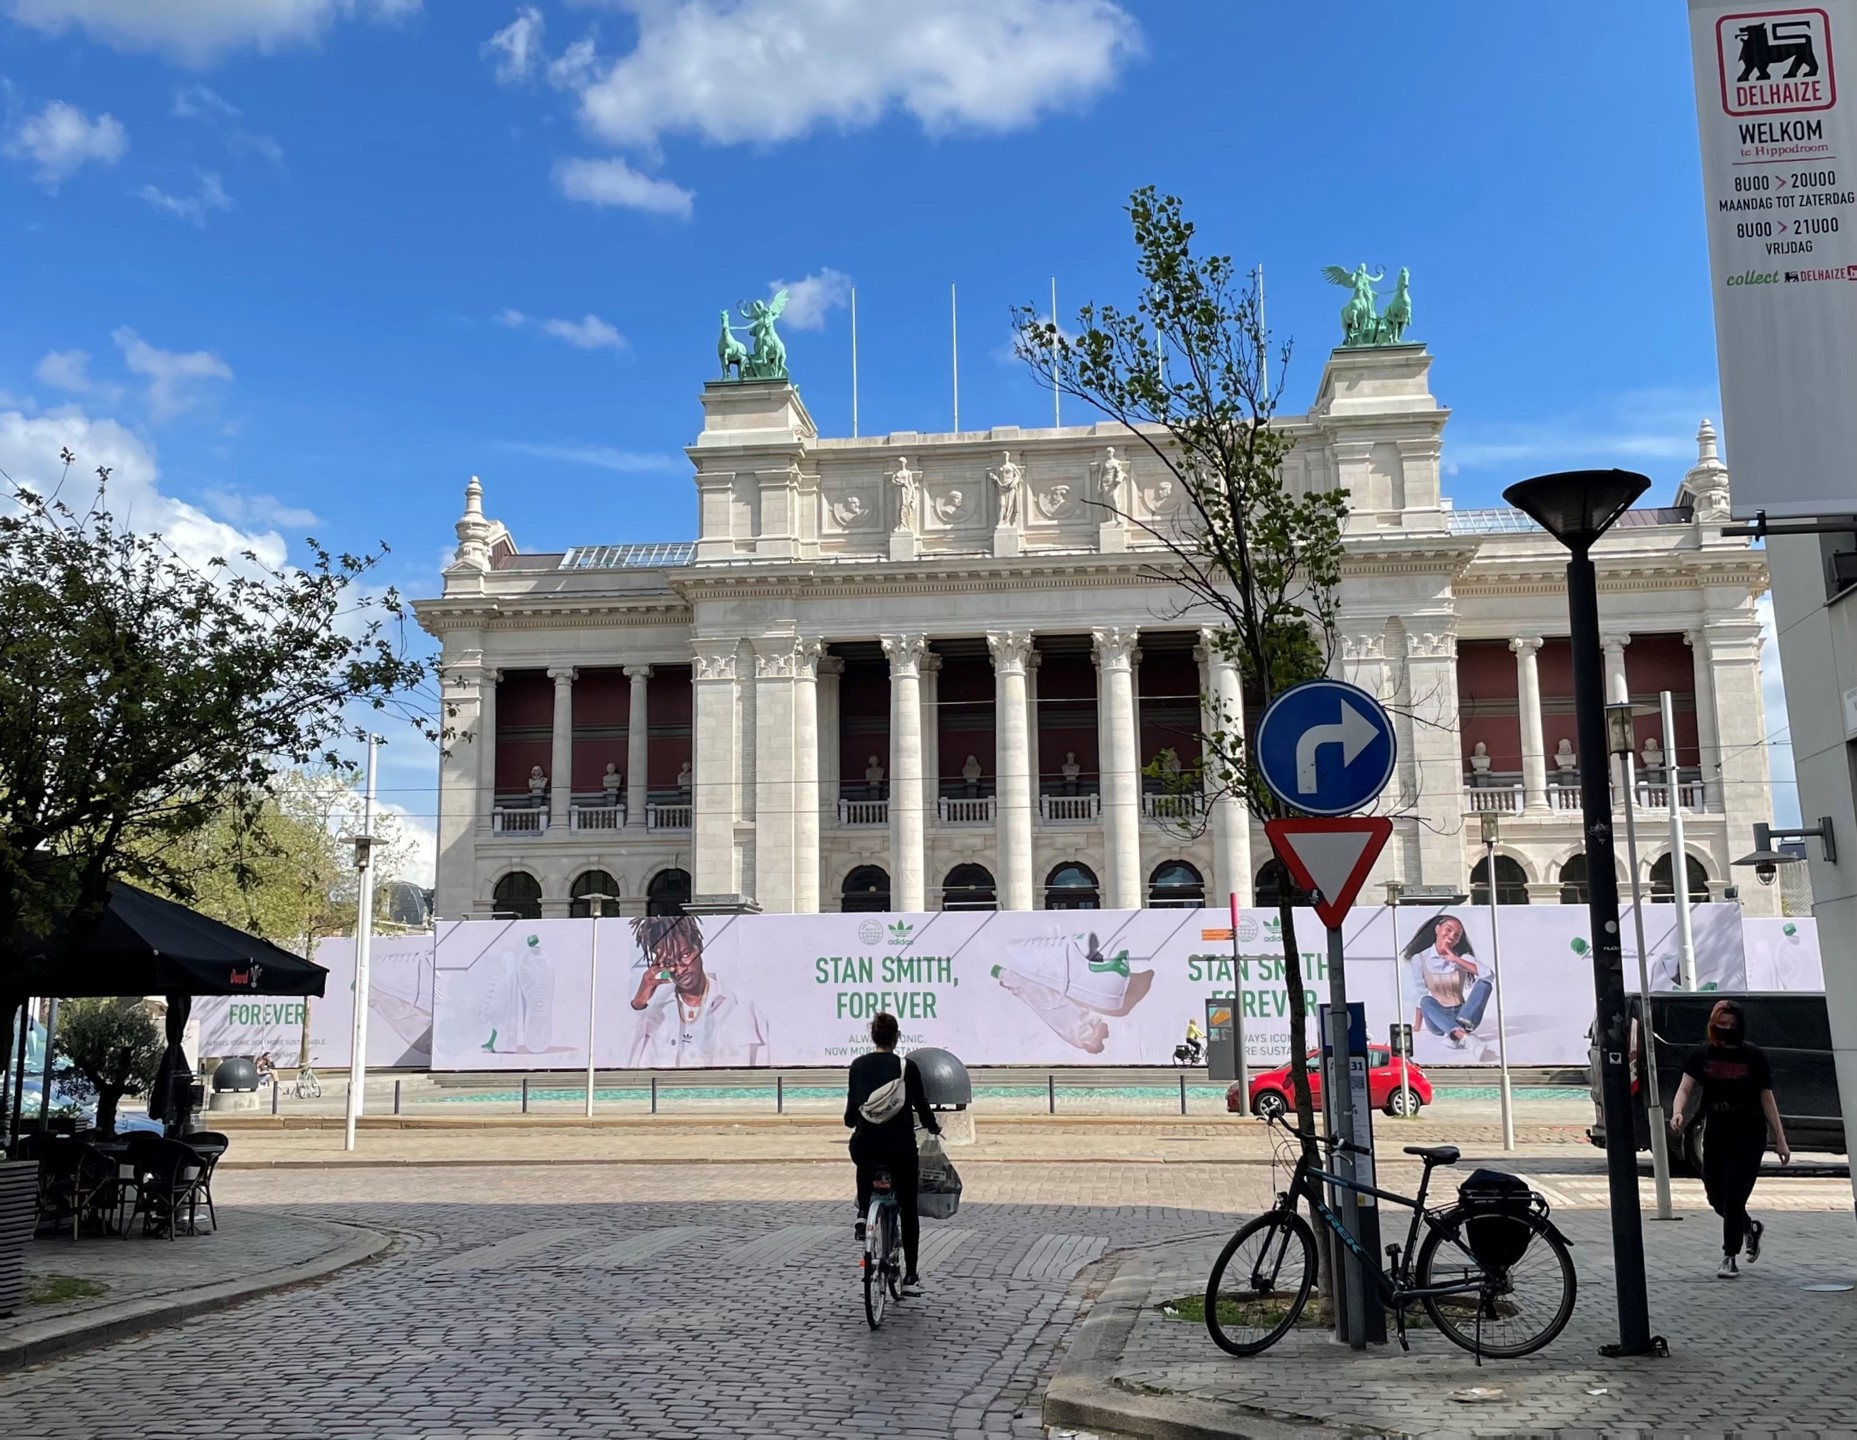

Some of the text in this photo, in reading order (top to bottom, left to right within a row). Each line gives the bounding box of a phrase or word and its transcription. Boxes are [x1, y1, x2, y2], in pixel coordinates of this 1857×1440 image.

[1736, 80, 1822, 107] DELHAIZE
[1739, 119, 1823, 144] WELKOM
[1741, 144, 1829, 157] te Hippodroom
[1734, 175, 1770, 192] 8U00
[1791, 170, 1836, 188] 20U00
[1719, 191, 1855, 212] MAANDAG TOT ZATERDAG
[1737, 222, 1772, 238] 8U00
[1793, 217, 1839, 235] 21U00
[1765, 240, 1813, 255] VRIJDAG
[1726, 267, 1847, 286] collect DELHAIZE
[815, 956, 959, 988] STAN SMITH,
[1188, 953, 1249, 981] STAN
[229, 1003, 304, 1025] FOREVER
[837, 991, 938, 1019] FOREVER
[824, 1046, 848, 1057] NOW
[1351, 1061, 1364, 1071] 31
